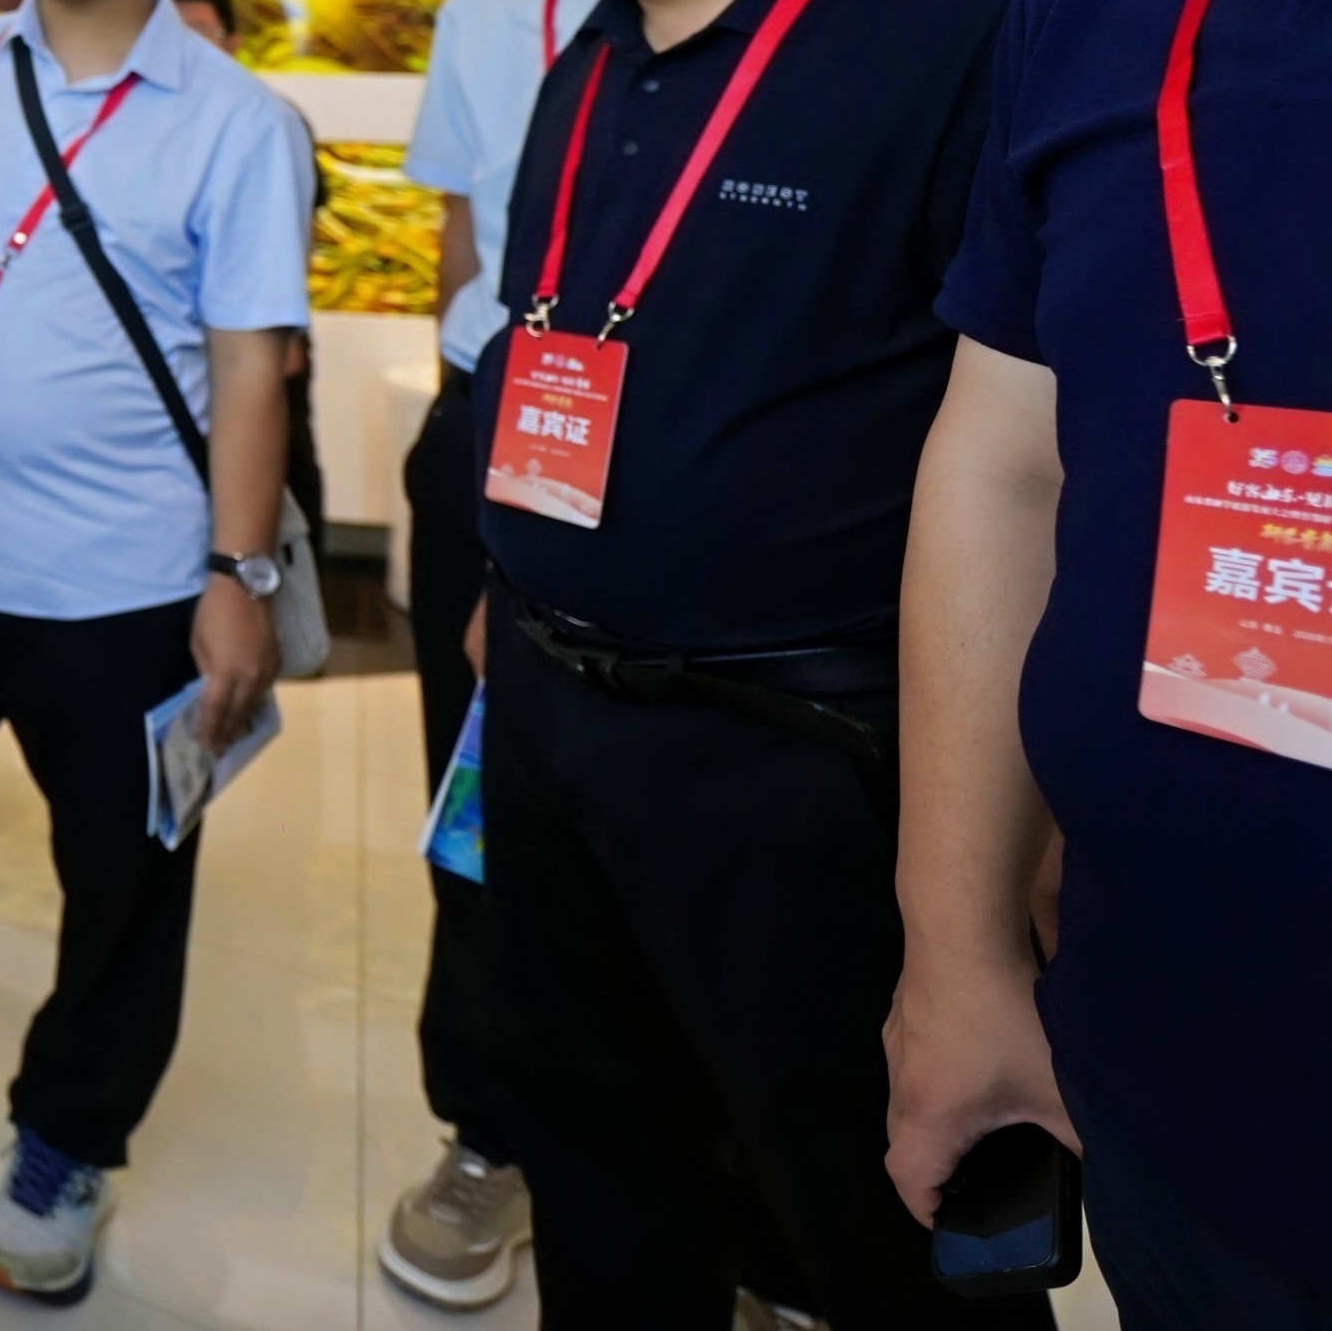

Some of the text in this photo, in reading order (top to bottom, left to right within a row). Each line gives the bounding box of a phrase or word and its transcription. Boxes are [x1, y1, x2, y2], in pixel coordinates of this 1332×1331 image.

[516, 404, 591, 446] 嘉宾证
[1204, 546, 1332, 614] 嘉宾
